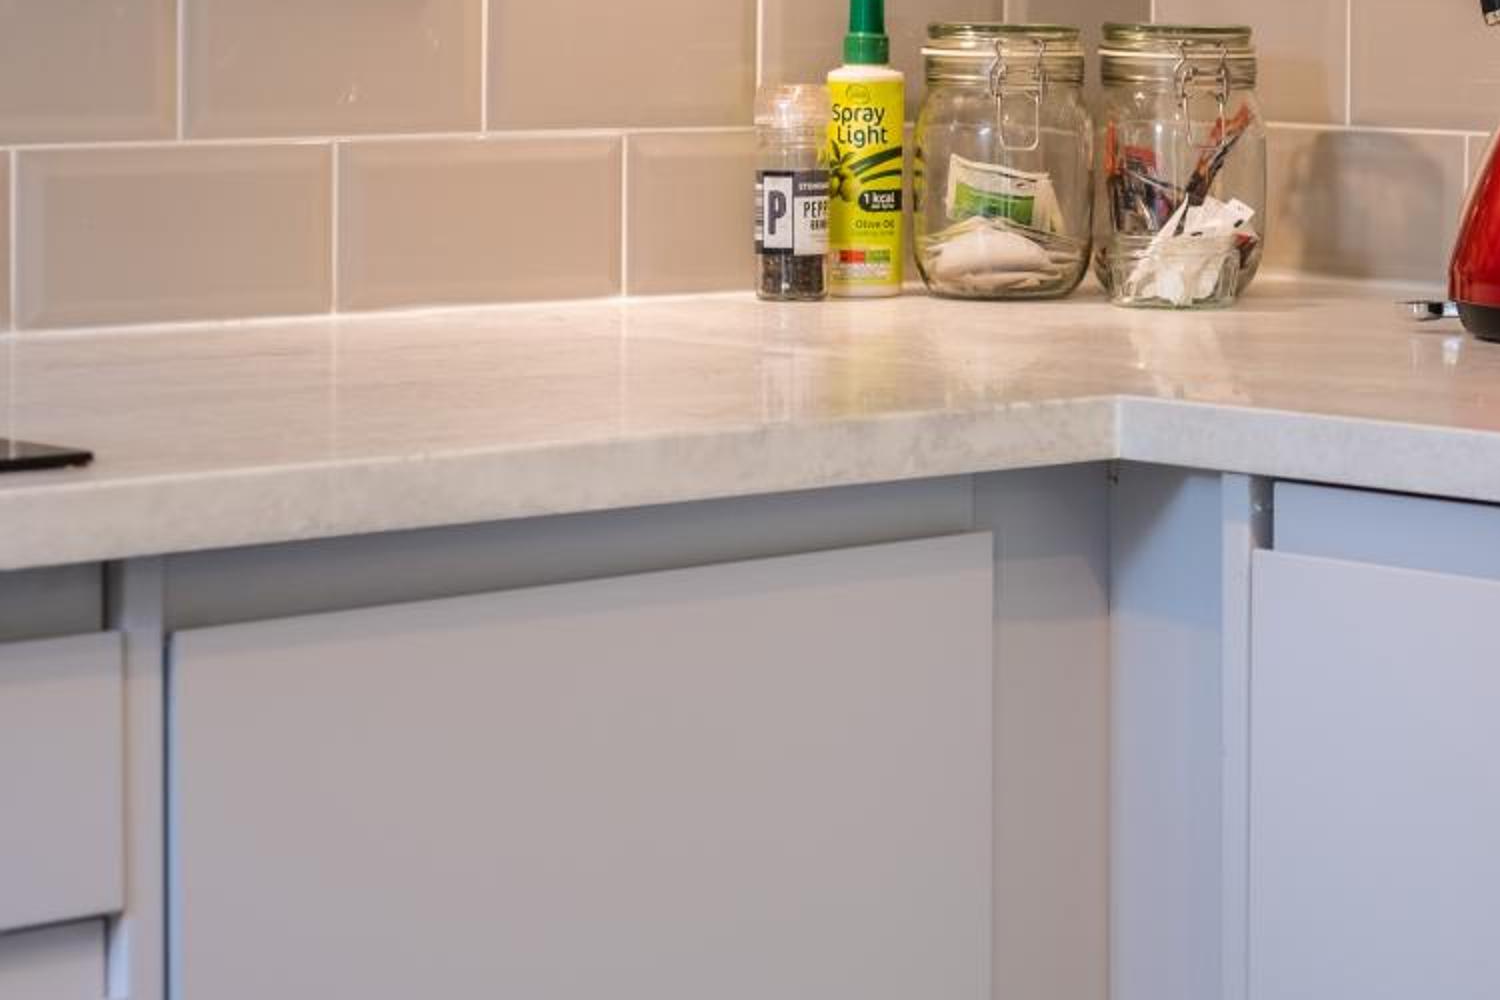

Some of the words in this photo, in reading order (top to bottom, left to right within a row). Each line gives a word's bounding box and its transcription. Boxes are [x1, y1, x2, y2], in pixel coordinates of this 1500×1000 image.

[831, 103, 885, 126] Spray
[837, 125, 888, 148] Light
[864, 193, 870, 204] 1
[871, 191, 896, 204] kcal
[767, 190, 787, 235] P
